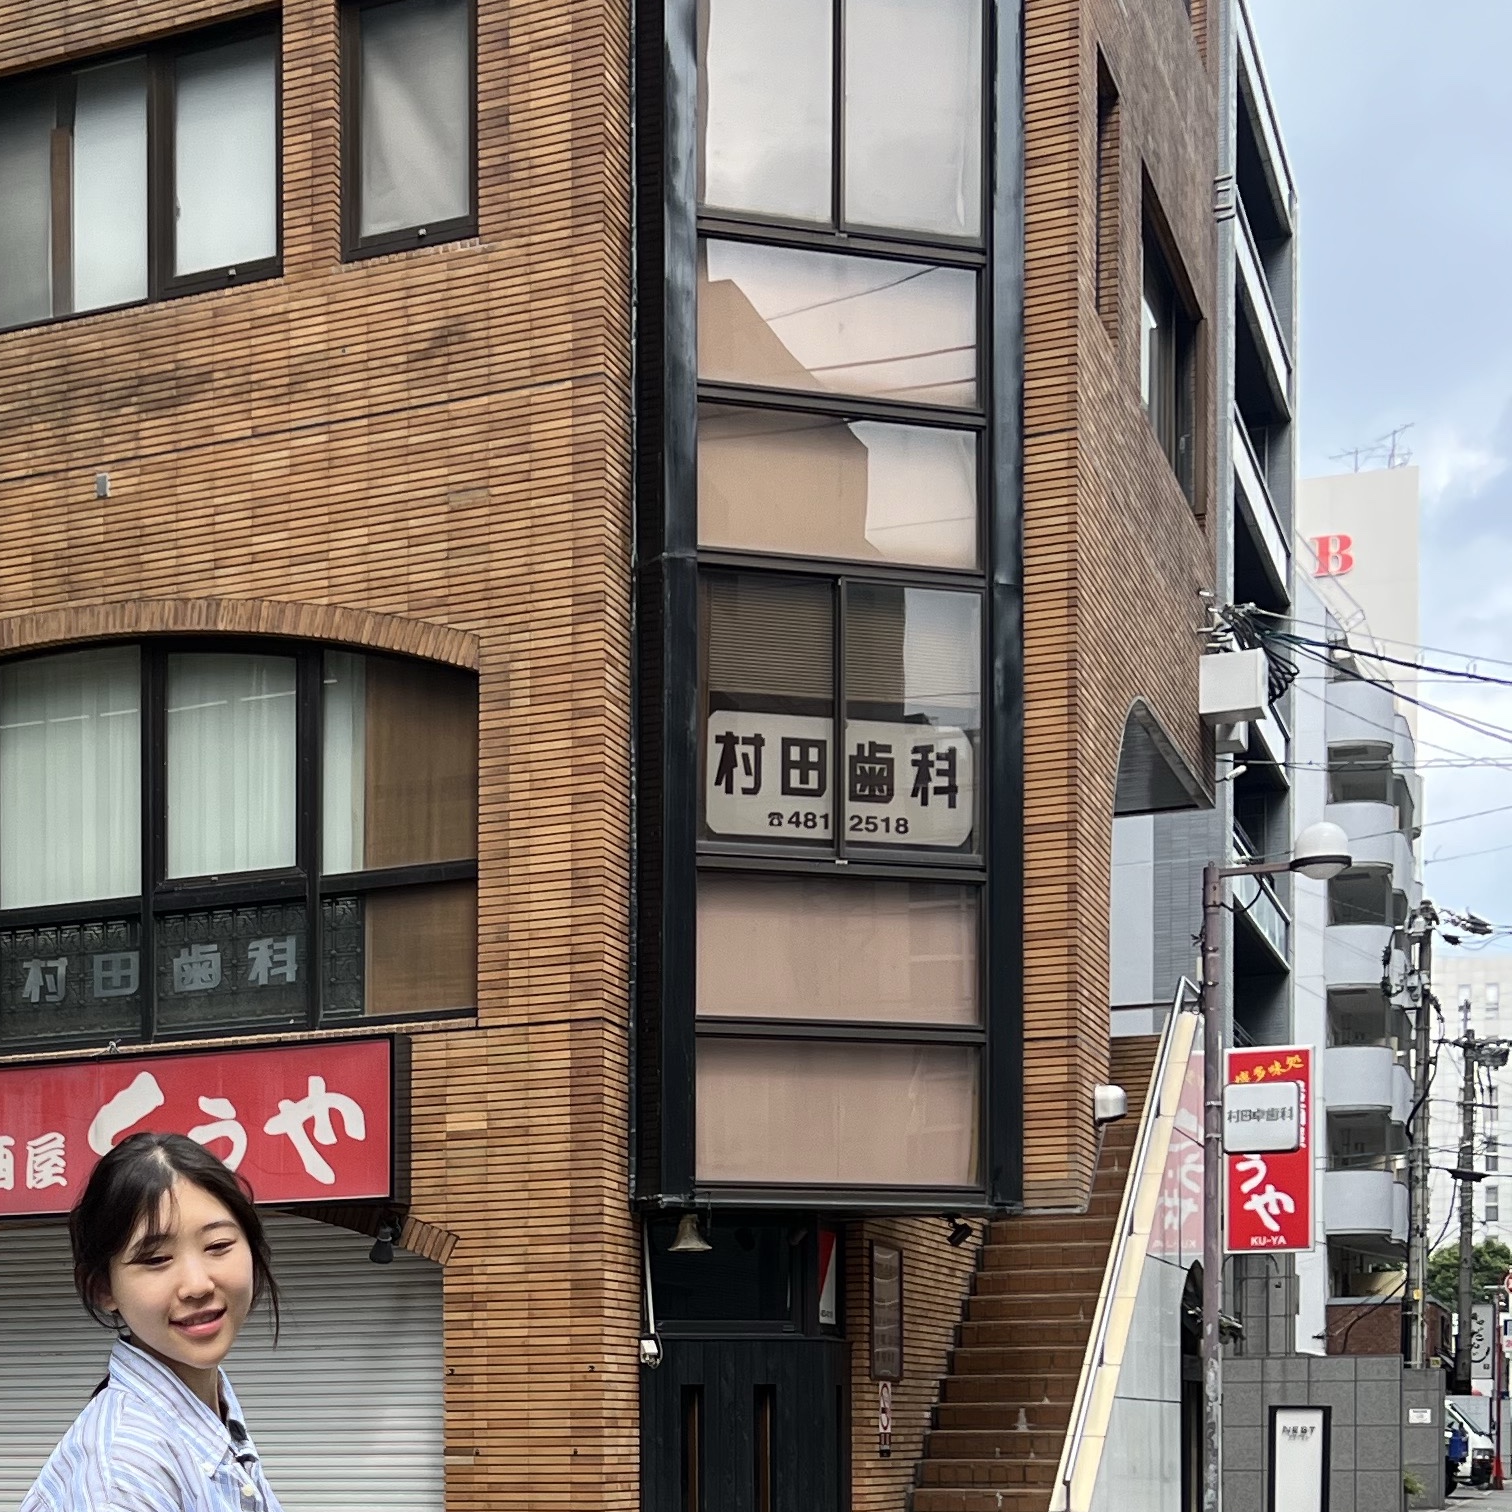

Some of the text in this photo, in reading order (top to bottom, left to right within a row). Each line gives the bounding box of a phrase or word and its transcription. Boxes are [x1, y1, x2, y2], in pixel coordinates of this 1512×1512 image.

[1310, 534, 1354, 578] B
[714, 730, 959, 810] 村田歯科
[788, 811, 909, 835] 481 2518
[22, 936, 298, 1003] 村田歯科
[1251, 1235, 1287, 1246] KU-YA
